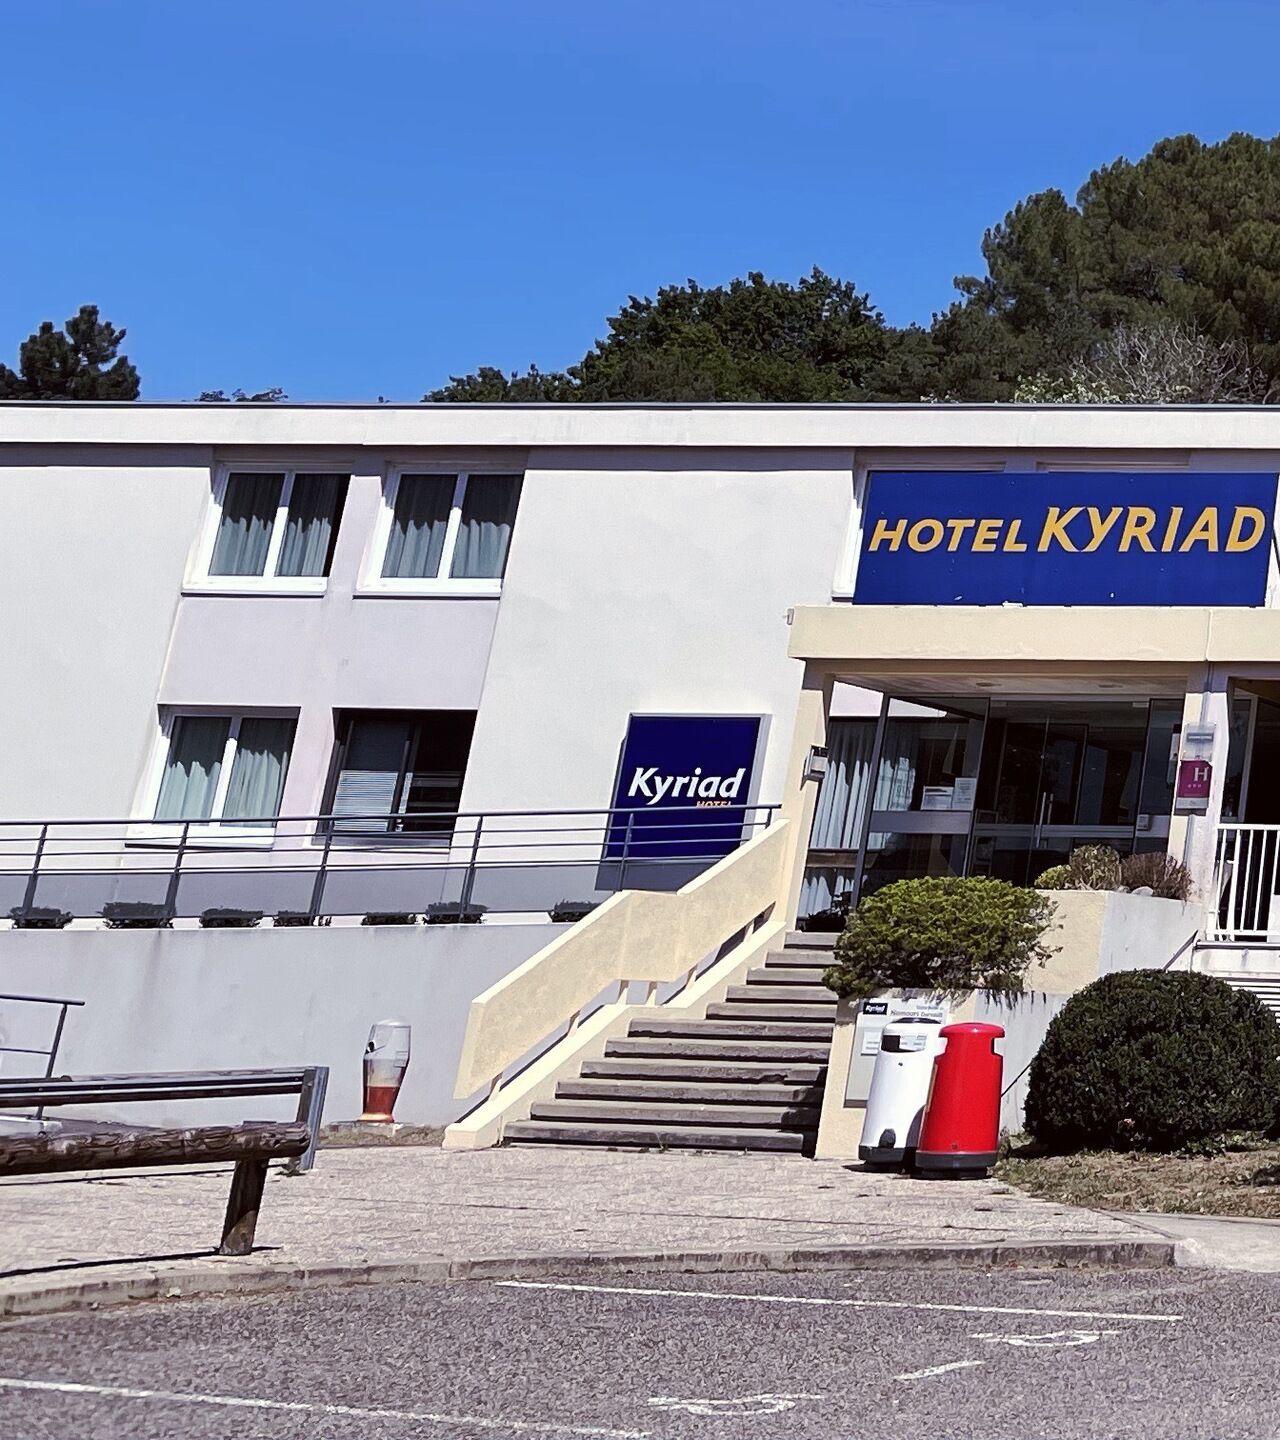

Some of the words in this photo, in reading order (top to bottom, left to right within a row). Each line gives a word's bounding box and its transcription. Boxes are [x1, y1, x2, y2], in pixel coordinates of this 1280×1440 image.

[867, 517, 1028, 554] HOTEL
[1037, 505, 1267, 554] KYRIAD
[628, 767, 746, 805] Kyriad
[1194, 767, 1209, 782] H
